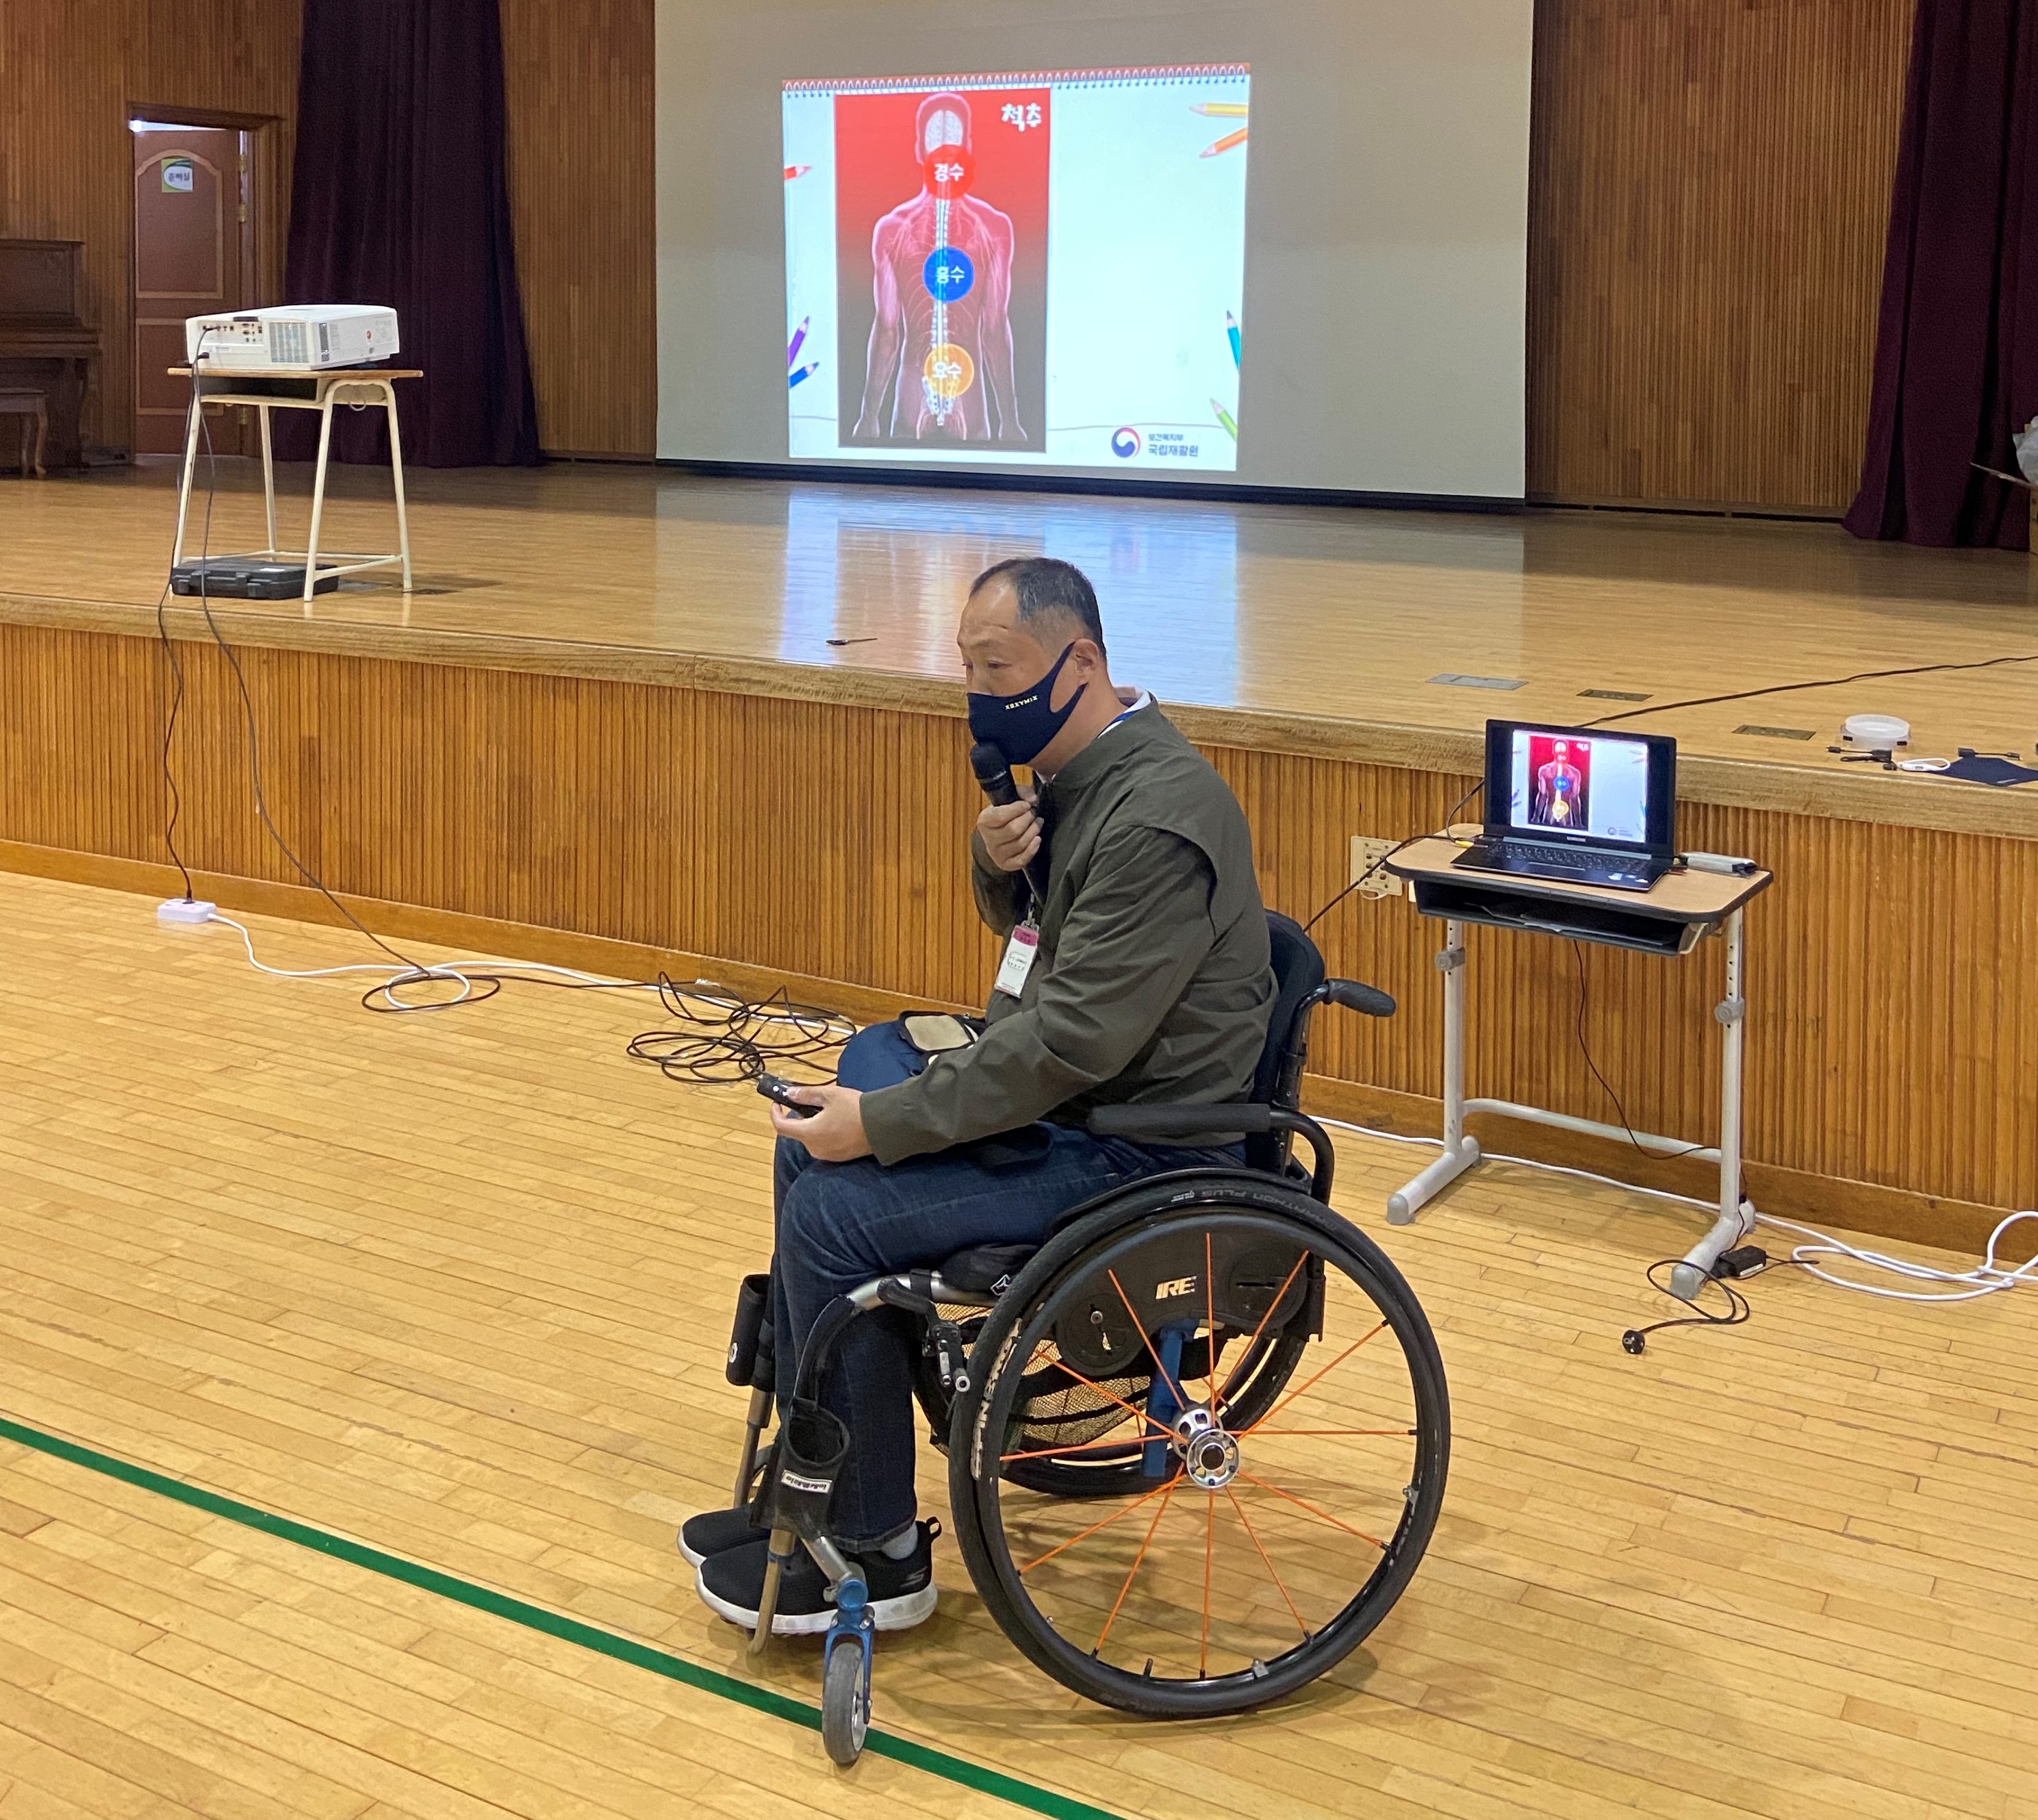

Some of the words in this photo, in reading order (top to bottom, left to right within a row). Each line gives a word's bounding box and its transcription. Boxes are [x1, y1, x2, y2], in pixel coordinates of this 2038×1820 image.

[1001, 103, 1041, 131] 척추
[934, 162, 965, 182] 경수
[932, 361, 963, 379] 요수
[1148, 444, 1199, 457] 국립재활원
